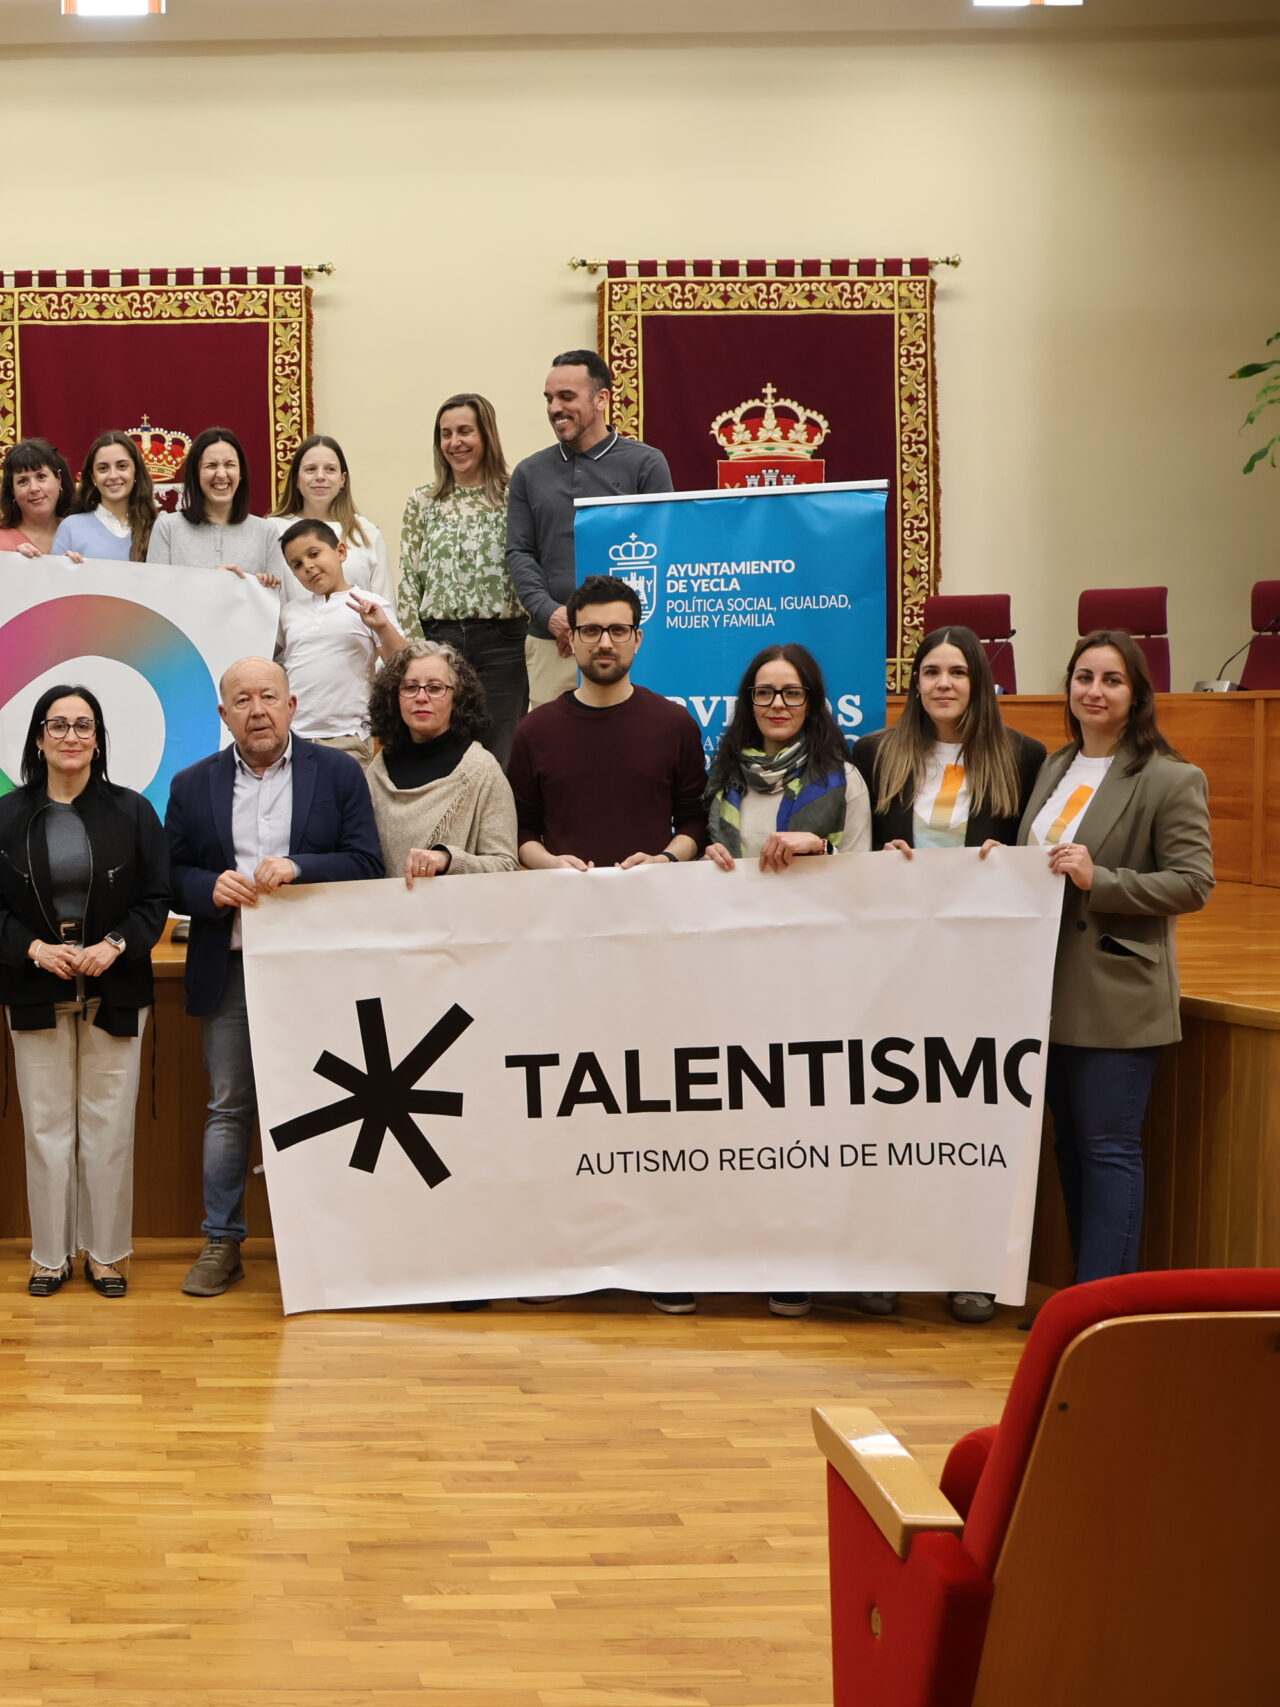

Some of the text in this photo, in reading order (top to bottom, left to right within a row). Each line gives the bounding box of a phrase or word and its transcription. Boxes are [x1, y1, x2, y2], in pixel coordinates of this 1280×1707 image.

[666, 559, 796, 578] AYUNTAMIENTO
[666, 577, 741, 593] DE YECLA
[666, 594, 852, 613] POLÍTICA SOCIAL, IGUALDAD,
[666, 613, 776, 629] MUJER Y FAMILIA
[576, 1140, 1008, 1176] AUTISMO REGIÓN DE MURCIA
